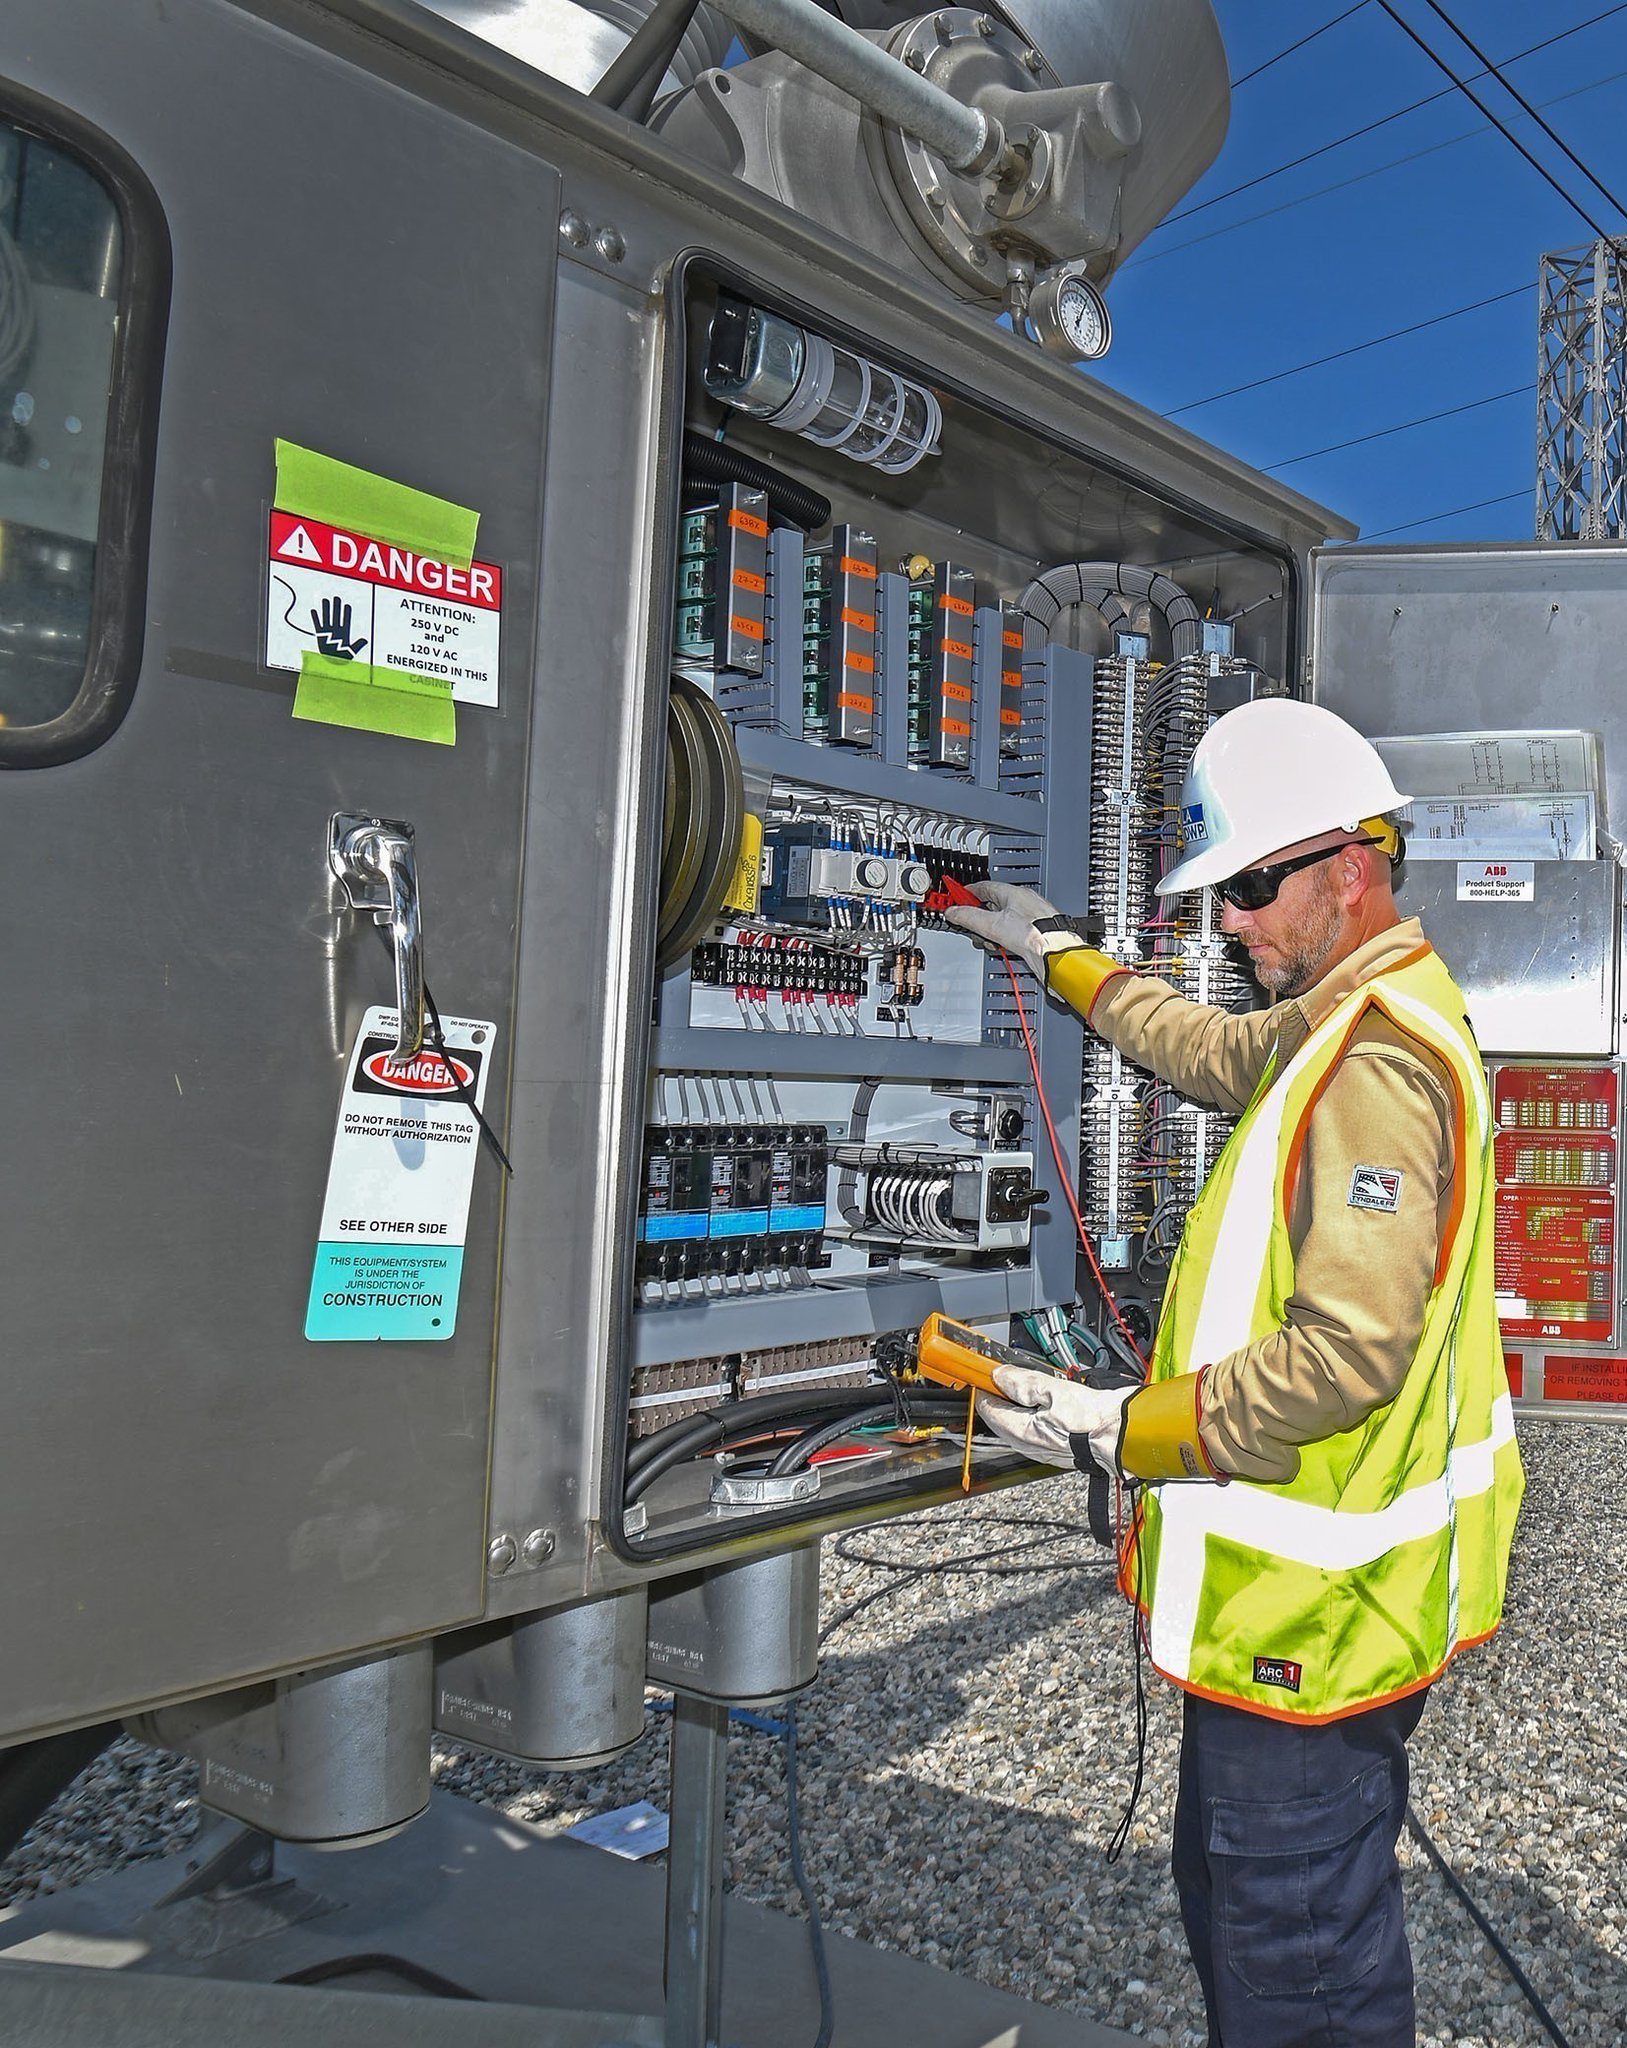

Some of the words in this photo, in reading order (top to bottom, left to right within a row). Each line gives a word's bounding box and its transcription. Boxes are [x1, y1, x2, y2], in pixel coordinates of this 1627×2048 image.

[332, 533, 494, 603] DANGER
[400, 598, 476, 624] ATTENTION:
[411, 618, 431, 630] 250
[433, 622, 442, 632] V
[444, 625, 459, 636] DC
[424, 633, 445, 643] and
[410, 643, 430, 655] 120
[432, 648, 441, 657] V
[443, 650, 458, 661] AC
[386, 654, 448, 674] ENERGIZED
[451, 666, 462, 677] IN
[464, 669, 488, 681] THIS
[1484, 866, 1507, 876] ABB
[1495, 880, 1525, 889] Support
[367, 1030, 399, 1040] CONSTRUCT
[344, 1113, 360, 1122] DO
[362, 1115, 384, 1125] NOT
[386, 1117, 428, 1129] REMOVE
[431, 1121, 452, 1131] THIS
[454, 1123, 474, 1133] TAG
[344, 1125, 391, 1137] WITHOUT
[392, 1130, 471, 1143] AUTHORIZATION
[1351, 1195, 1384, 1206] TYNDALE
[339, 1220, 366, 1231] SEE
[369, 1221, 414, 1233] OTHER
[417, 1223, 448, 1234] SIDE
[330, 1256, 351, 1266] THIS
[353, 1257, 447, 1268] EQUIPMENT/SYSTEM
[354, 1269, 364, 1278] IS
[366, 1269, 399, 1278] UNDER
[401, 1270, 419, 1279] THE
[345, 1281, 410, 1290] JURISDICTION
[412, 1281, 425, 1290] OF
[323, 1293, 443, 1307] CONSTRUCTION
[1541, 1325, 1561, 1335] ABB
[1550, 1375, 1564, 1384] OR
[1567, 1376, 1620, 1387] REMOVING
[1577, 1390, 1614, 1401] PLEASE
[1259, 1666, 1283, 1678] ARC
